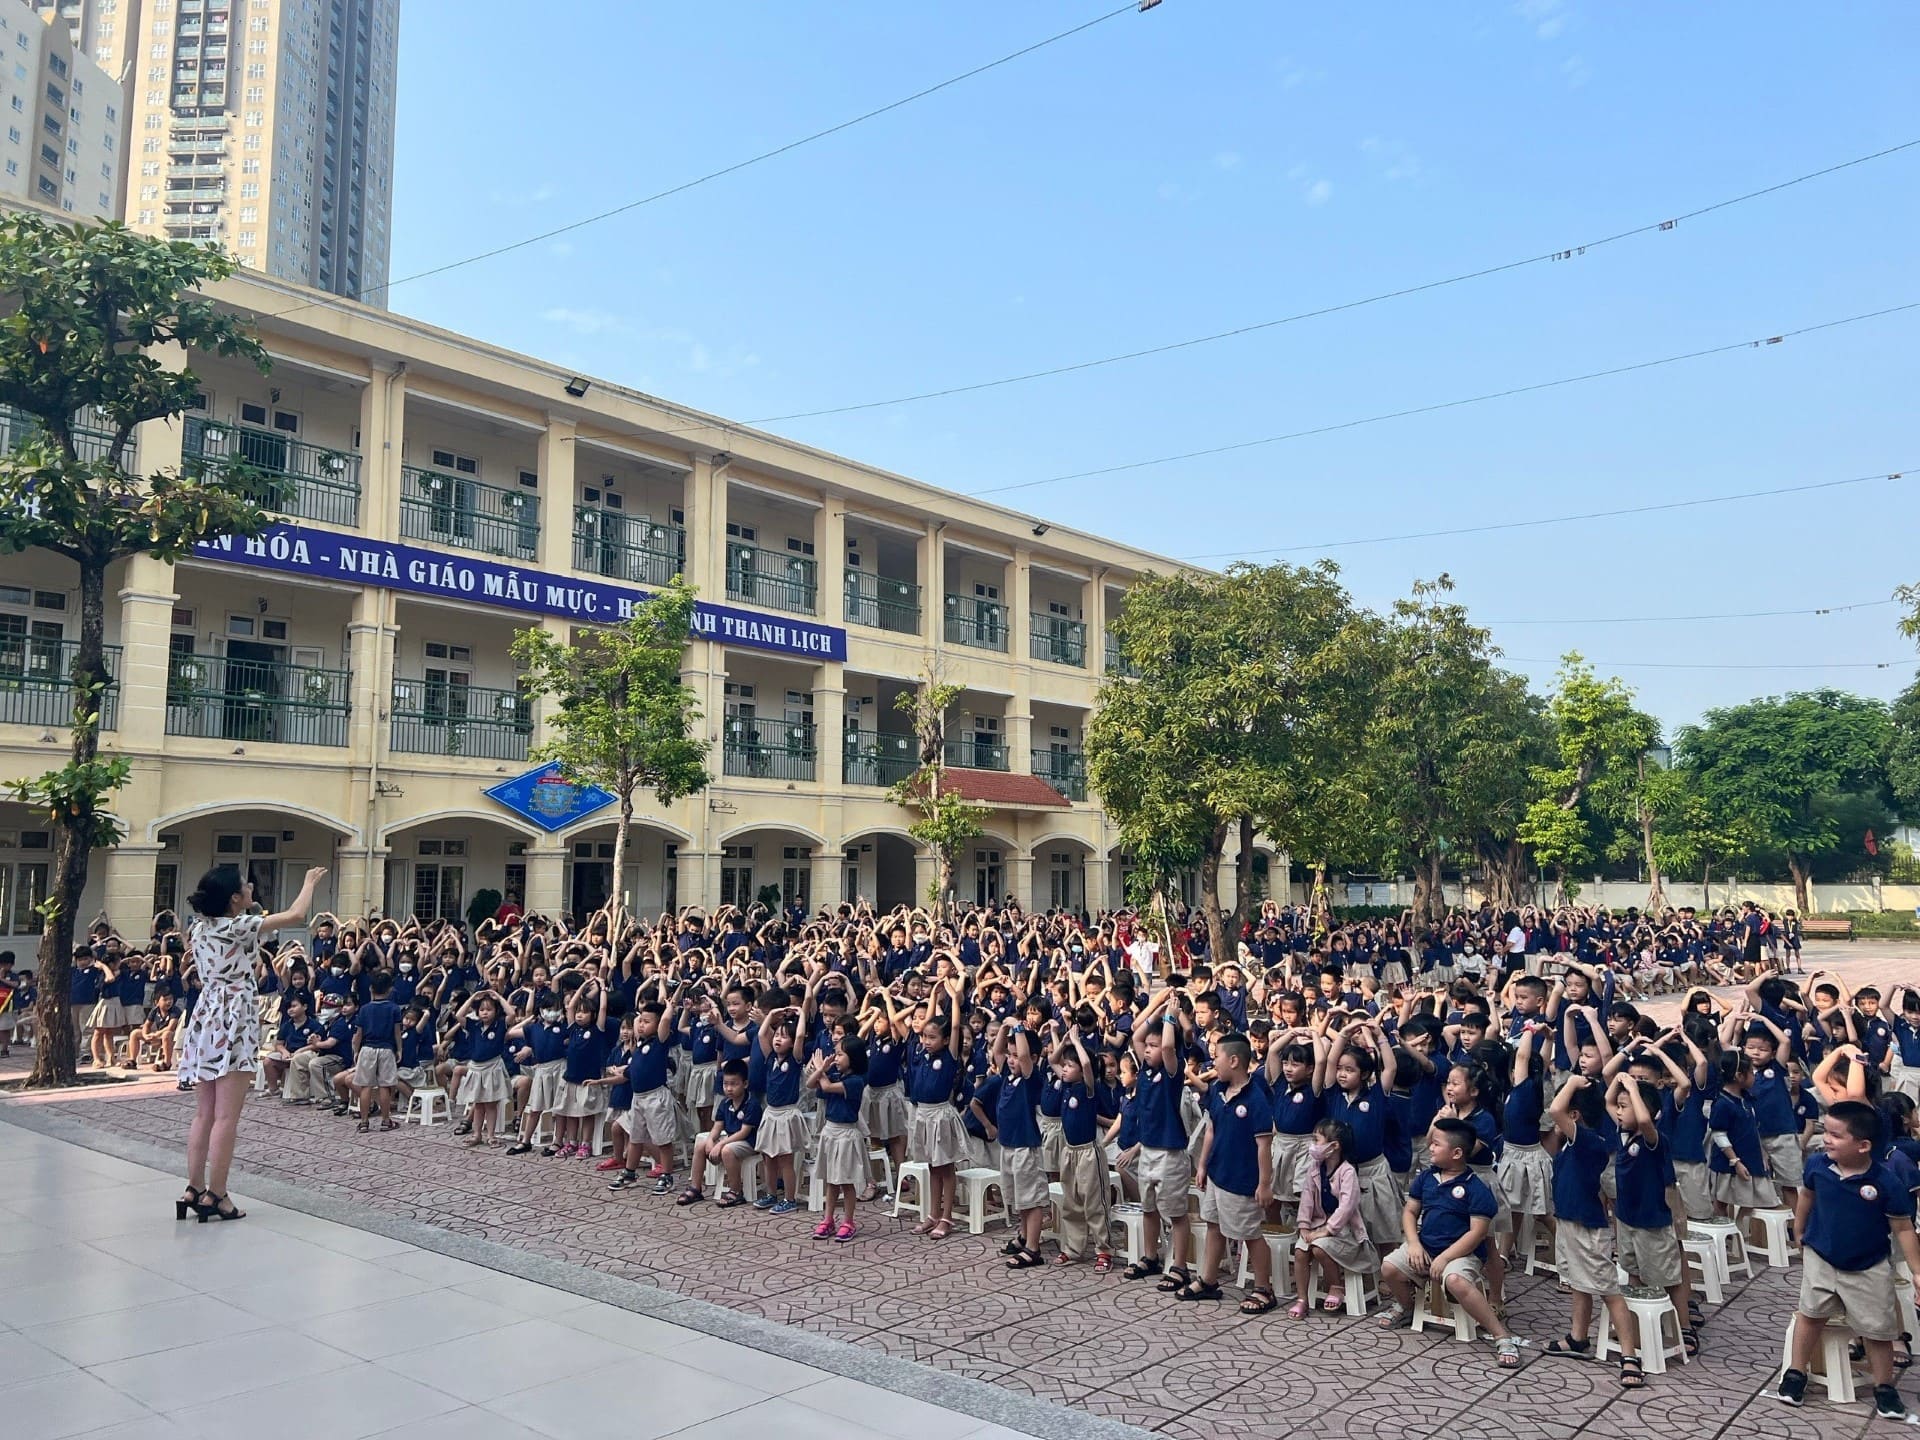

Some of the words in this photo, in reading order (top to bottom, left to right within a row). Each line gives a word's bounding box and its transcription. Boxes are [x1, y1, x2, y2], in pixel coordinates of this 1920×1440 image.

[245, 531, 311, 565] HÓA
[339, 547, 400, 580] NHÀ
[408, 560, 475, 592] GIÁO
[482, 570, 539, 603] MẪU
[545, 586, 597, 614] MỰC
[722, 616, 786, 646] THANH
[791, 629, 832, 653] LỊCH
